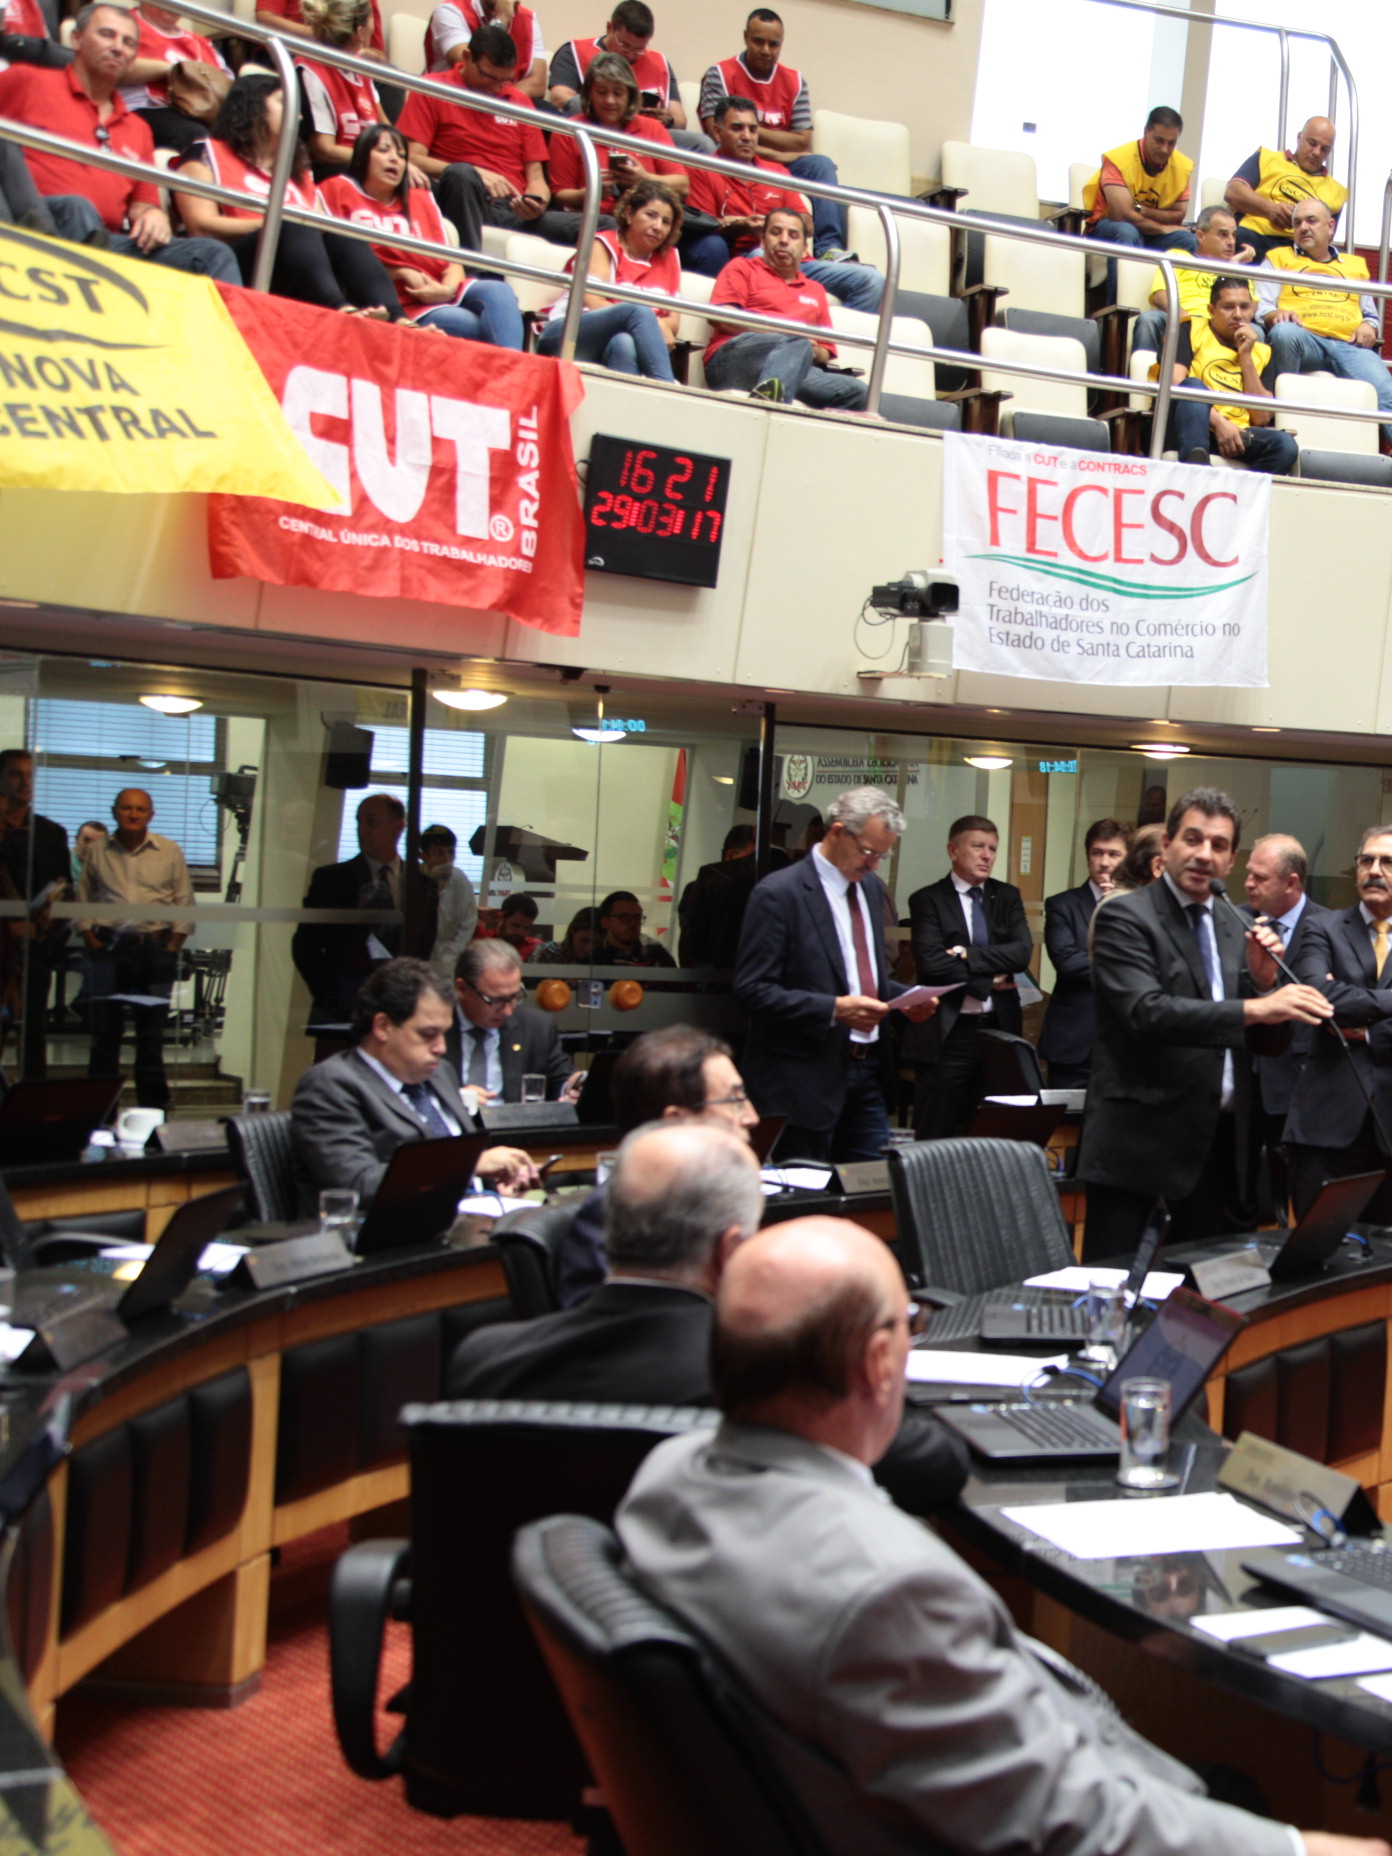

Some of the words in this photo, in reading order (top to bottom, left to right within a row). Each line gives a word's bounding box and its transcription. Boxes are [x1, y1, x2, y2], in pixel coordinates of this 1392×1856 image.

[0, 353, 140, 397] NOVA
[518, 405, 541, 558] BRASIL
[1033, 453, 1058, 467] CUT
[1078, 459, 1147, 476] CONTRACS
[278, 516, 337, 543] CENTRAL
[340, 527, 391, 548] ÚNICA
[986, 469, 1239, 568] FECESC
[988, 581, 1074, 613] Federação
[1079, 594, 1110, 613] dos
[987, 603, 1104, 636] Trabalhadores
[1110, 621, 1130, 637] no
[1135, 619, 1216, 638] Comércio
[1222, 621, 1241, 638] no
[988, 626, 1045, 651] Estado
[1050, 635, 1071, 654] de
[1077, 638, 1121, 658] Santa
[1126, 641, 1194, 659] Catarina
